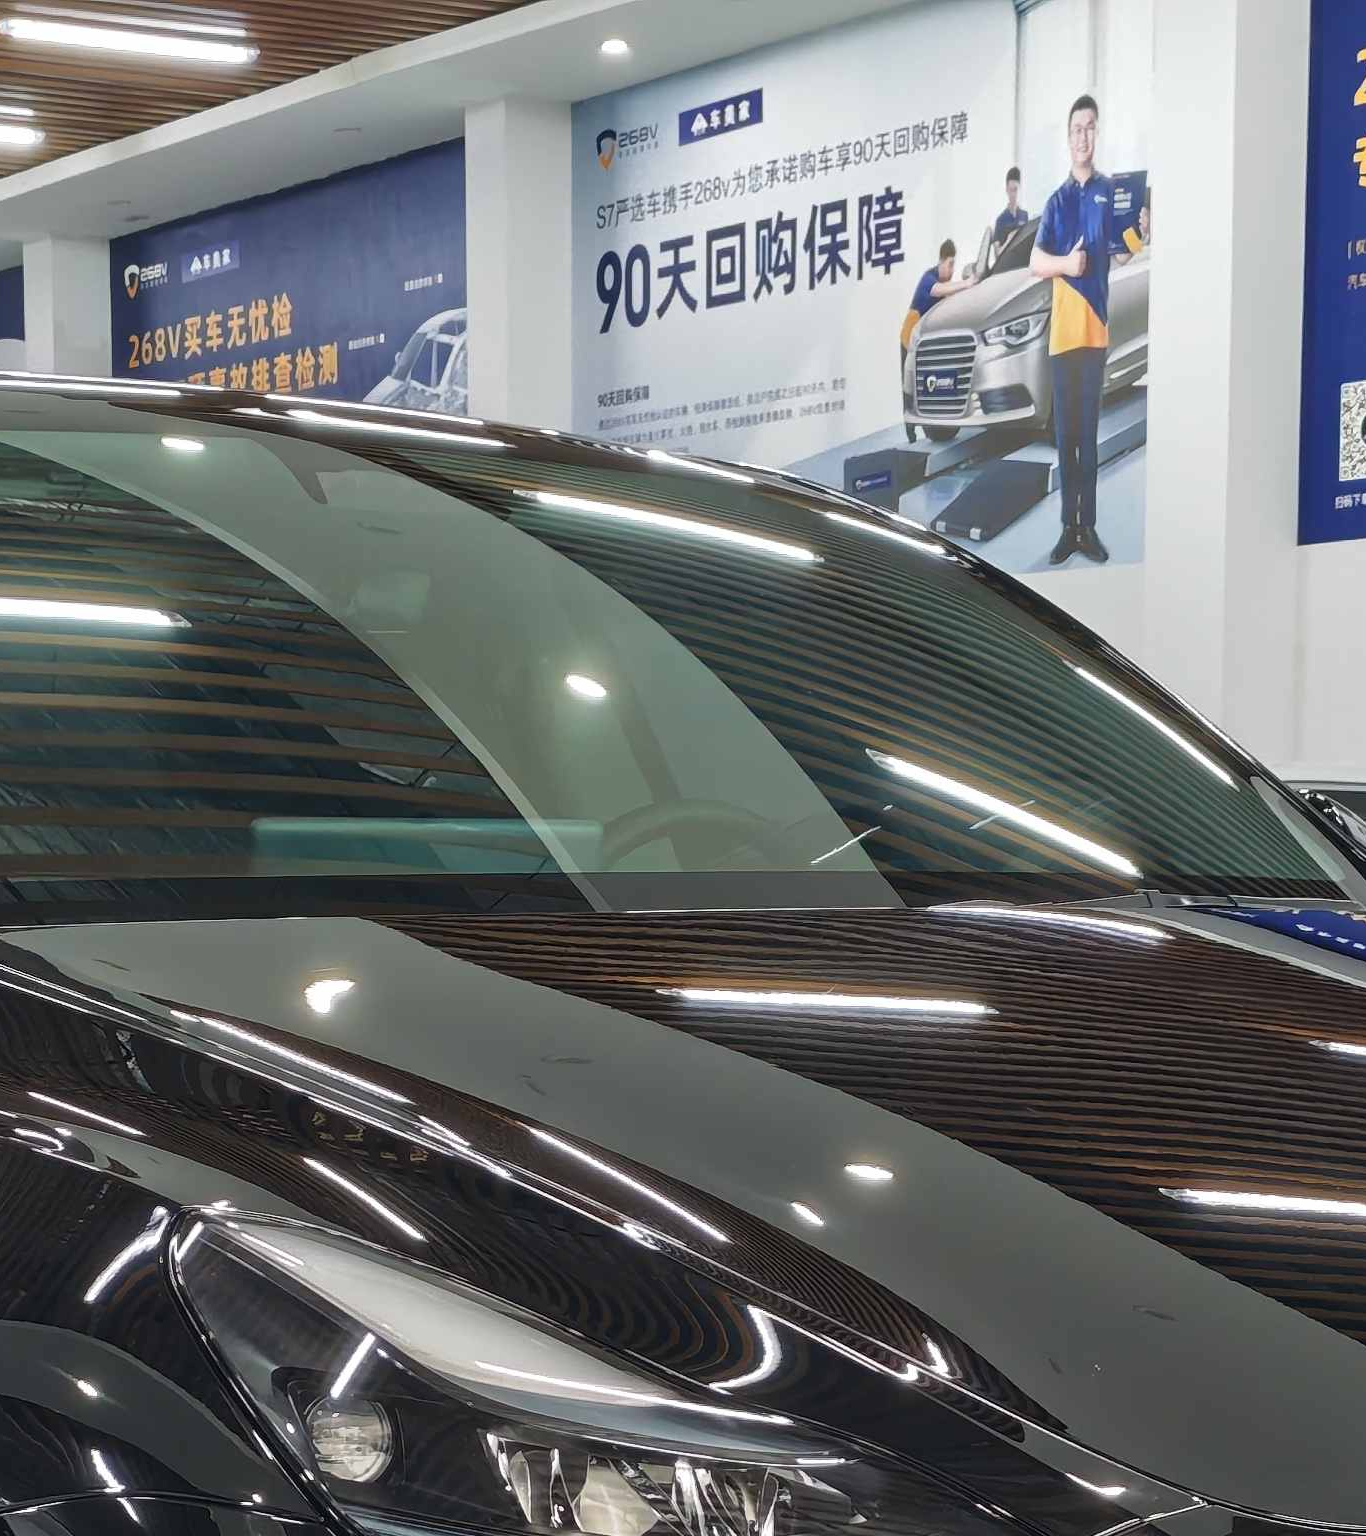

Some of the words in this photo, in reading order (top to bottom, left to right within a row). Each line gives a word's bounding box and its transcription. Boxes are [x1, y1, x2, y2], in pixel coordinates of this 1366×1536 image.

[619, 123, 659, 148] 268V
[596, 185, 905, 334] 90天回购保障
